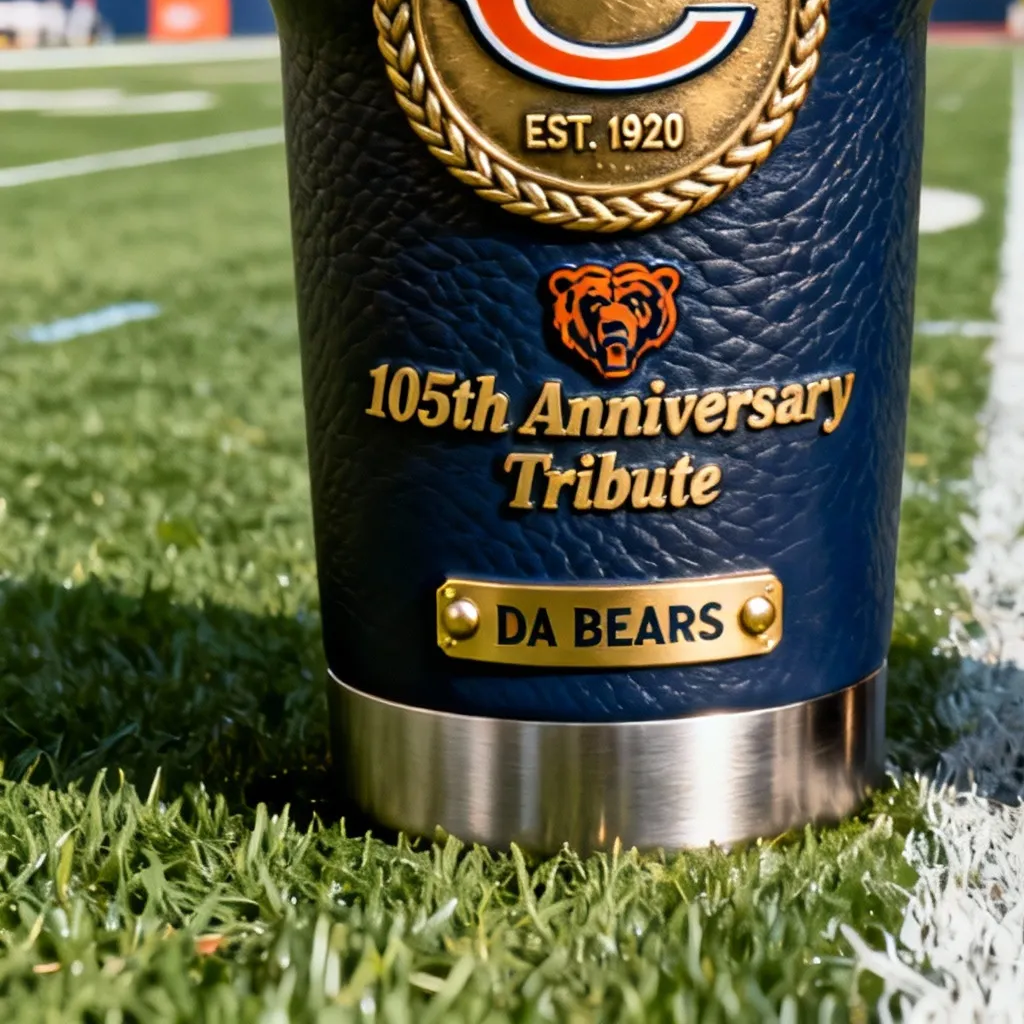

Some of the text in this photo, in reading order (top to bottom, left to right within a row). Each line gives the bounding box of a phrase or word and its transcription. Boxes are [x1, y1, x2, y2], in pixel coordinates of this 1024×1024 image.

[526, 112, 685, 150] EST. 1920
[364, 363, 857, 437] 105th Anniversary
[503, 452, 723, 511] Tribute
[496, 601, 725, 648] DA BEARS
